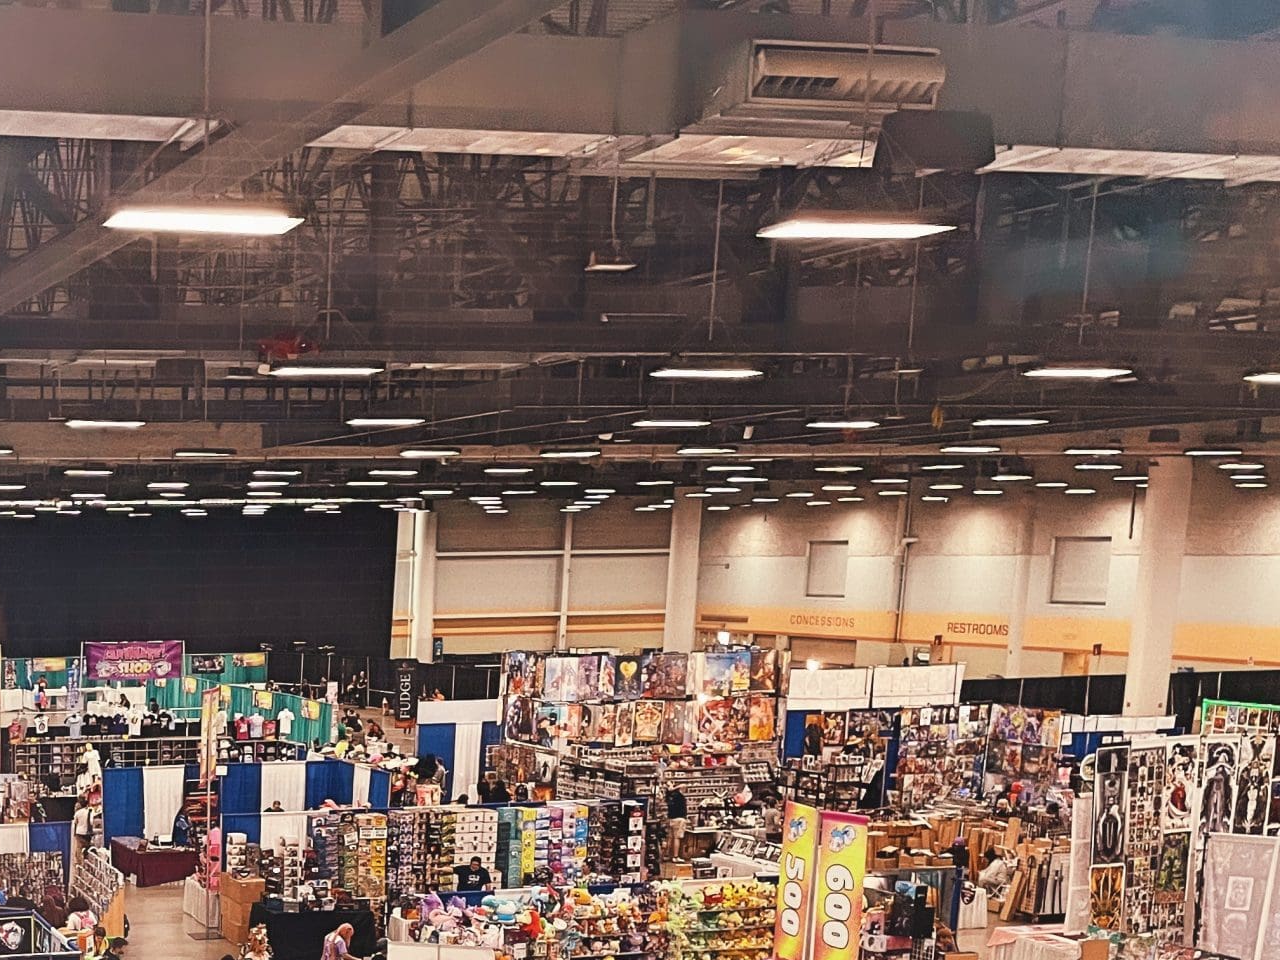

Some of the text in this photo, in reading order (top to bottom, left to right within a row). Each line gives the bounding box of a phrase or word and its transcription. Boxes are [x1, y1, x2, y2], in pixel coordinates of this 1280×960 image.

[790, 614, 855, 628] CONCESSIONS
[947, 622, 1009, 636] RESTROOMS
[117, 661, 152, 674] SHOP
[399, 673, 412, 719] FUDGE
[781, 853, 806, 938] 500
[822, 863, 855, 949] 600
